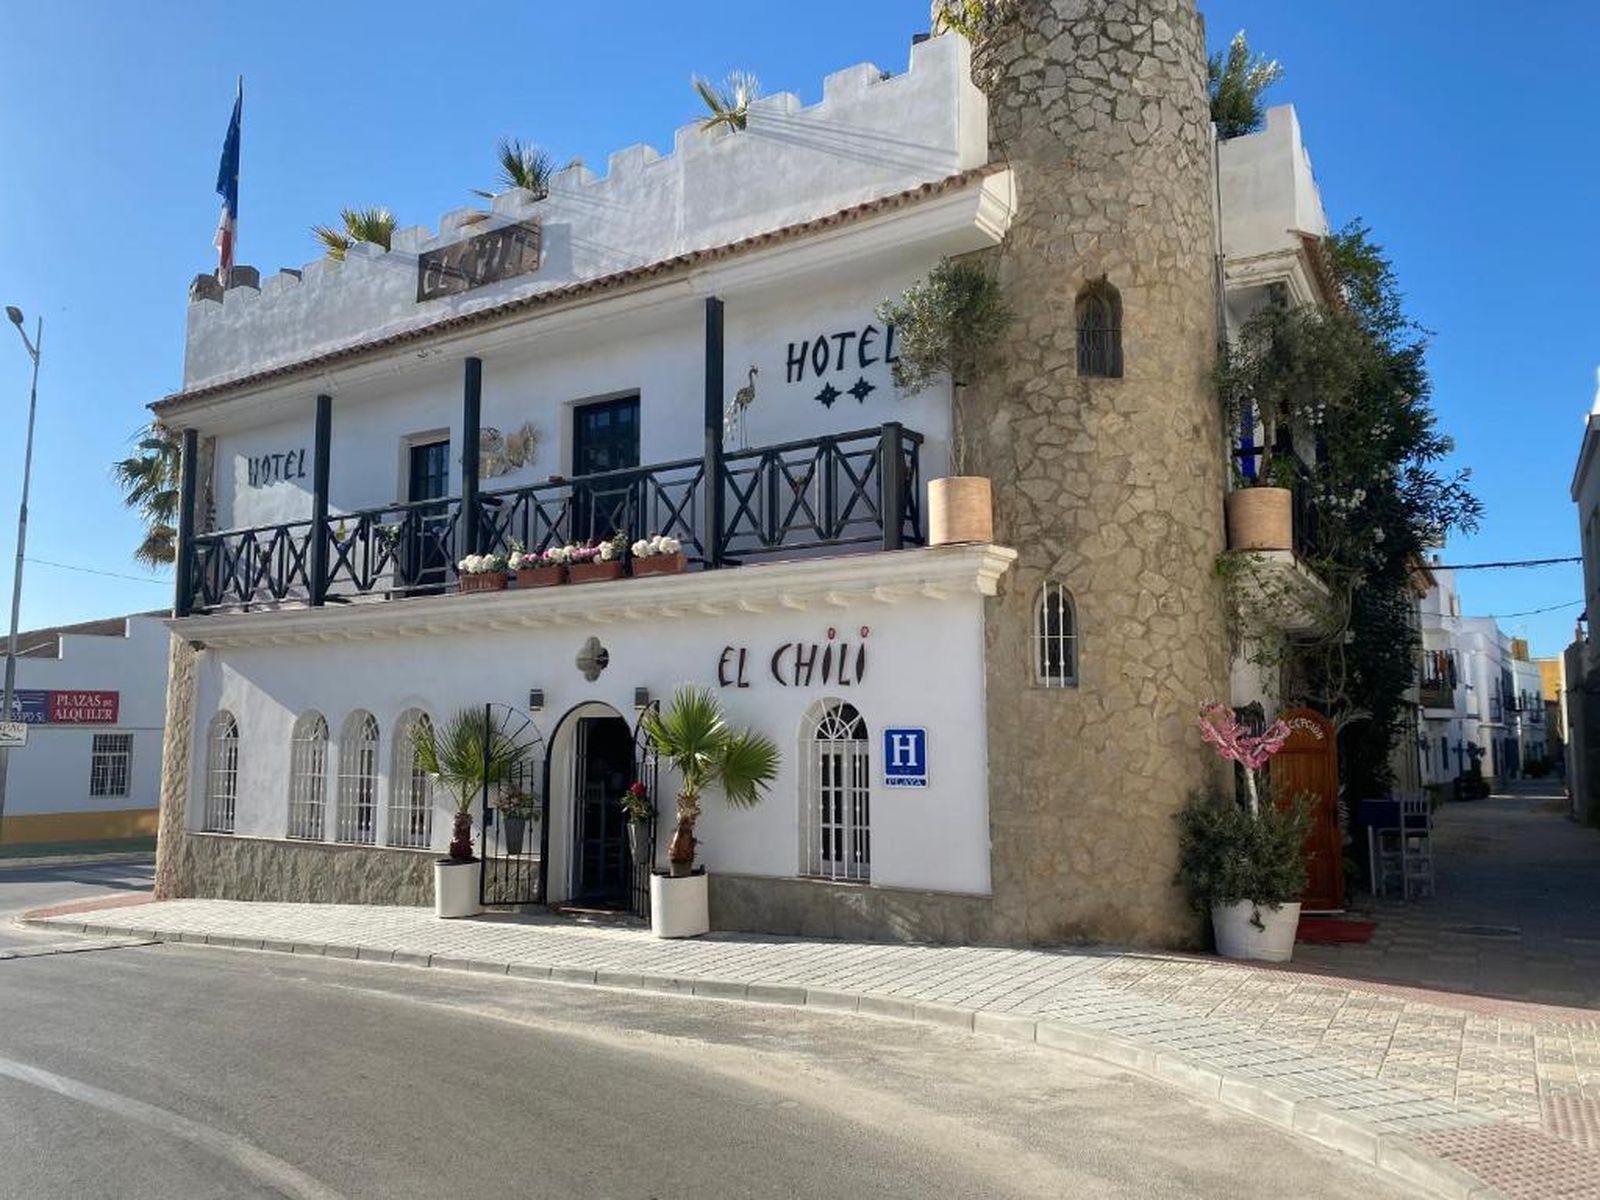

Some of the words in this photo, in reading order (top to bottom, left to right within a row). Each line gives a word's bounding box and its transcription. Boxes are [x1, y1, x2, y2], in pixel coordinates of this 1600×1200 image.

[786, 324, 900, 383] HOTEL
[248, 448, 306, 487] HOTEL
[718, 646, 749, 688] EL
[54, 708, 112, 721] ALQUILER
[56, 694, 101, 707] PLAZAS
[891, 734, 918, 767] H
